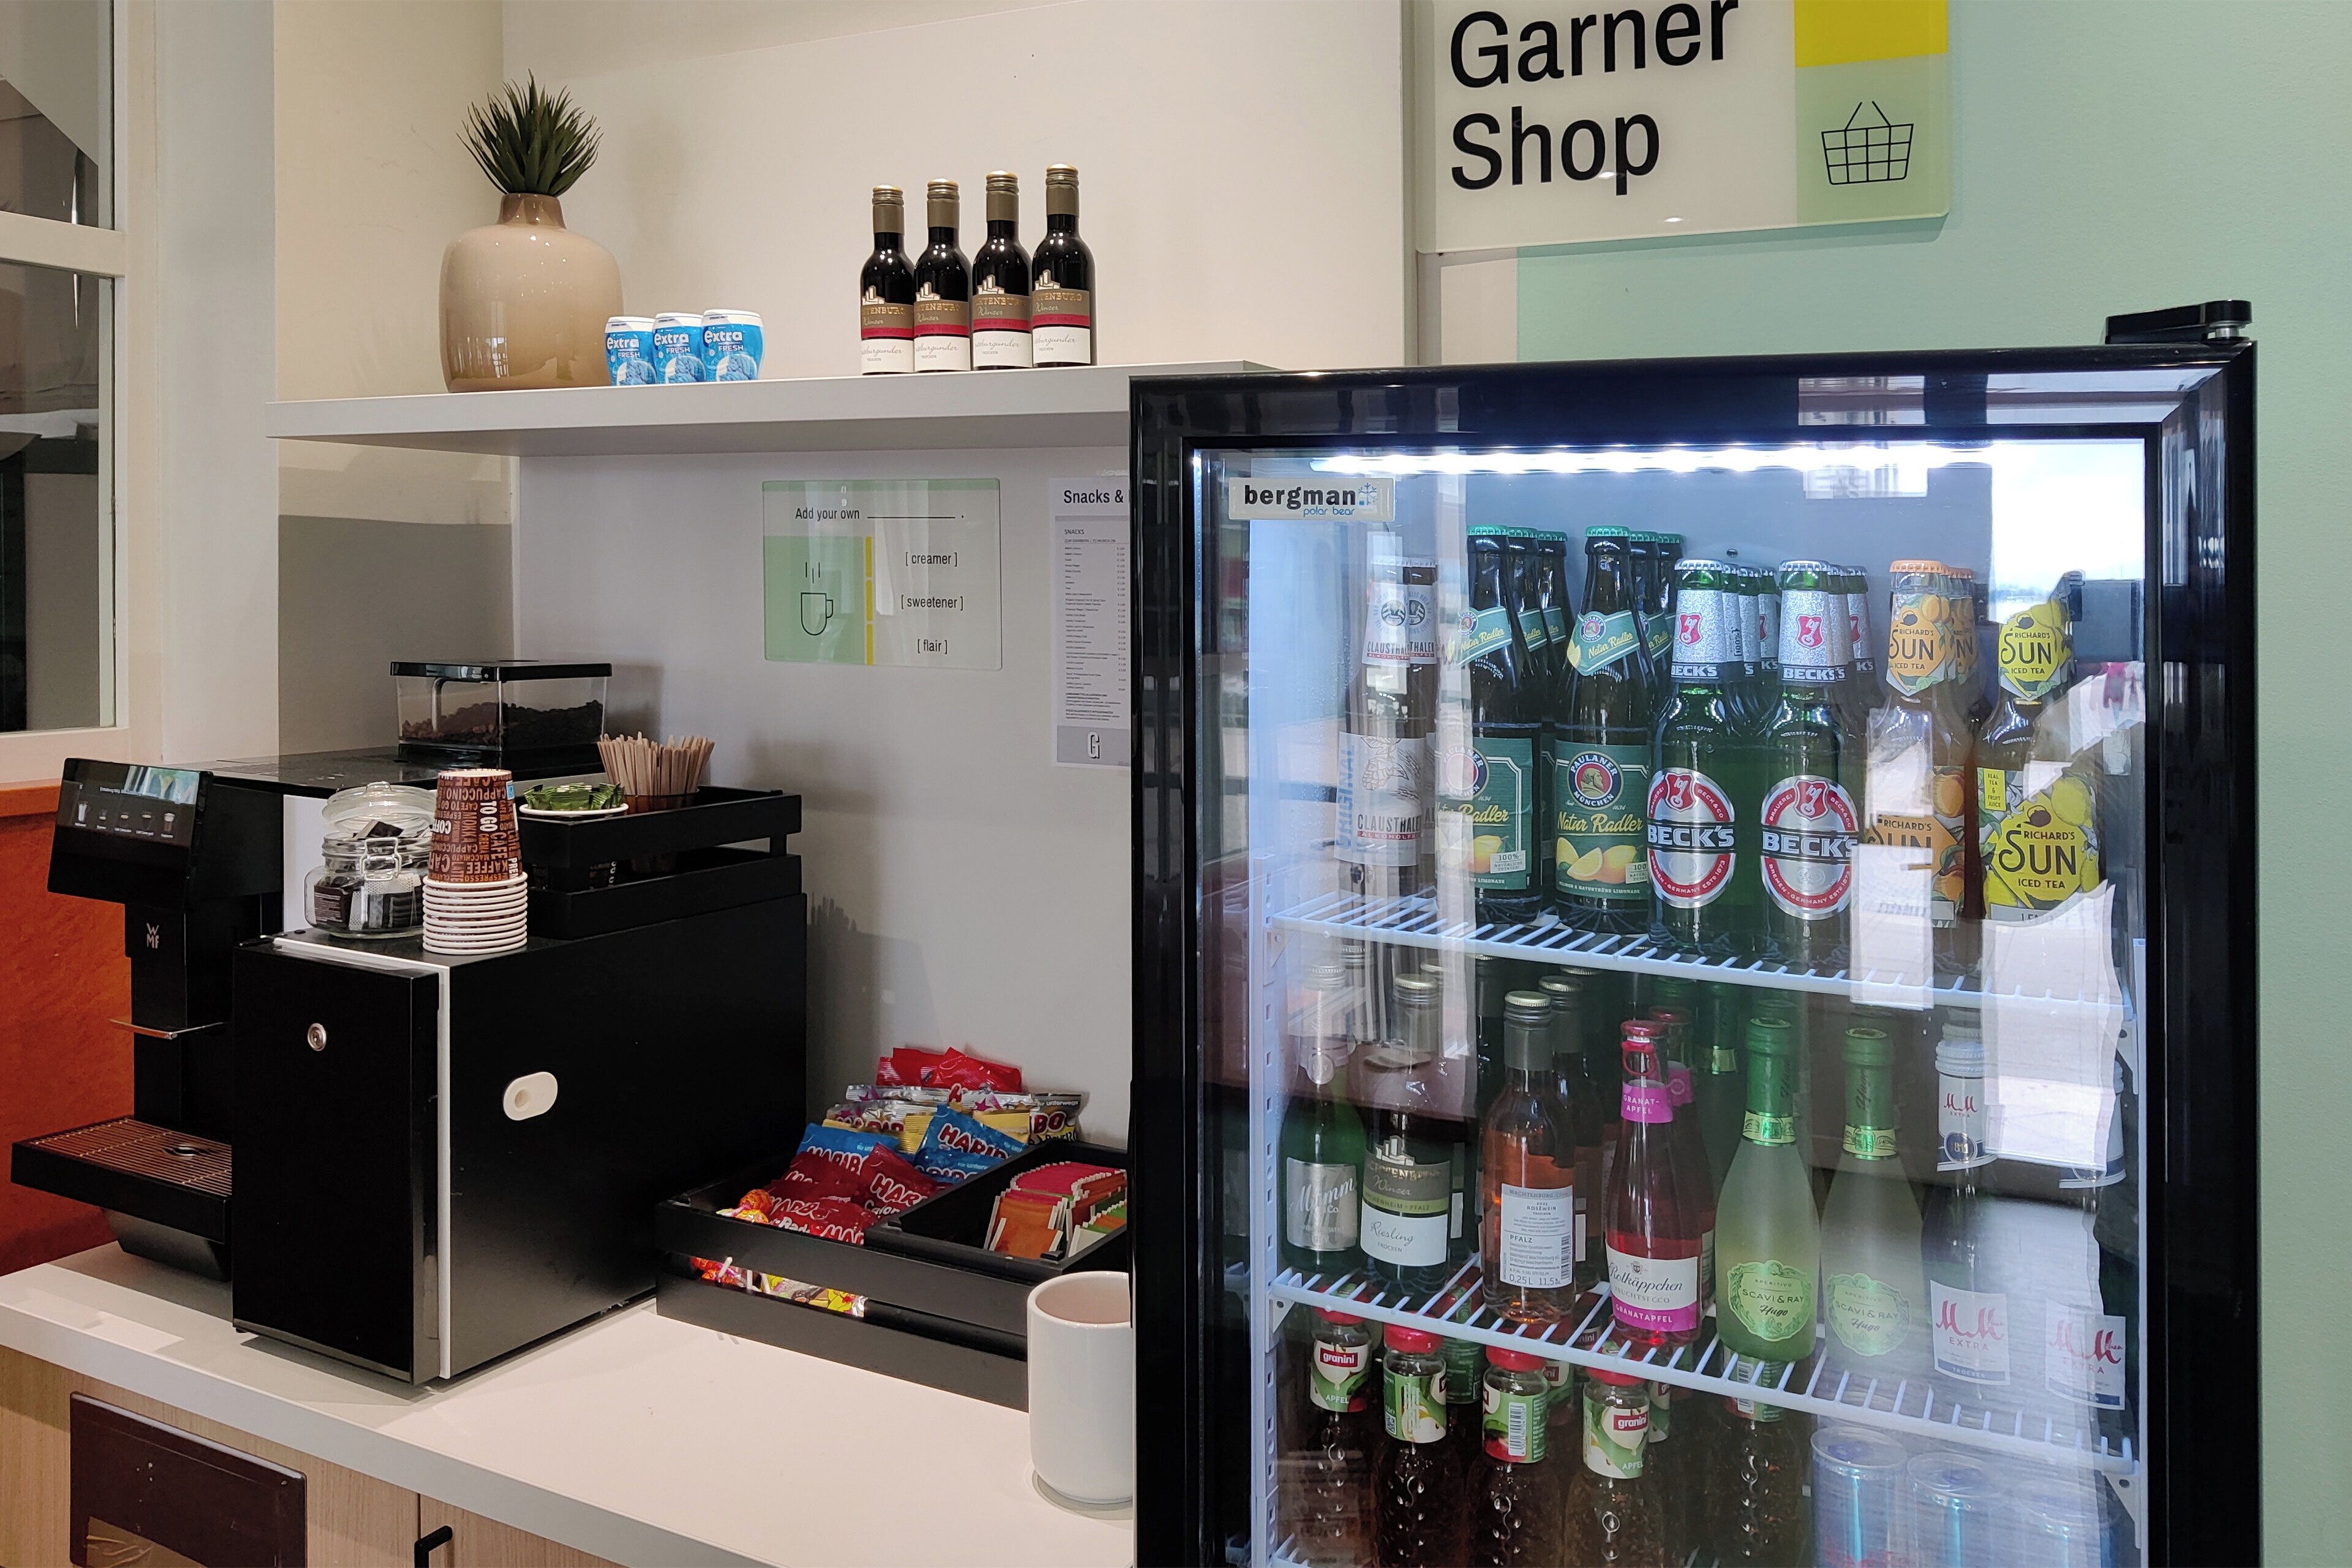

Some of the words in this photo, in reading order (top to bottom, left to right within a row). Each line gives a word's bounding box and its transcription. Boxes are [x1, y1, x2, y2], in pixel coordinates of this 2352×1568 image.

[1450, 0, 1738, 88] Garner
[1451, 106, 1660, 196] Shop
[606, 336, 639, 350] extra
[654, 332, 689, 347] extra
[704, 330, 743, 344] extra
[1063, 489, 1110, 503] Snacks
[1114, 489, 1124, 503] &
[1244, 484, 1356, 510] bergman
[795, 508, 815, 519] Add
[816, 509, 838, 522] your
[840, 508, 860, 519] own
[1303, 506, 1328, 518] polar
[1332, 506, 1355, 516] bear
[1478, 627, 1506, 643] Radler
[1588, 639, 1610, 660] Natur
[1607, 632, 1634, 649] Radler
[1888, 625, 1934, 662] SUN
[2000, 628, 2052, 665] SUN
[1570, 753, 1618, 777] PAULANER
[446, 787, 507, 801] CAPPUCCINO
[1573, 790, 1615, 807] MÜNCHEN
[440, 801, 450, 810] GO
[450, 801, 461, 811] TO
[461, 802, 478, 810] CAFE
[480, 801, 497, 815] TO
[1458, 803, 1509, 824] Radler
[1768, 793, 1793, 822] BRAUEREI
[461, 812, 477, 843] MOKKA
[480, 816, 498, 832] GO
[1557, 811, 1589, 834] Natur
[1590, 812, 1643, 834] Radler
[1883, 820, 1932, 831] RICHARD'S
[478, 833, 489, 854] CREMA
[1647, 824, 1735, 848] BECK'S
[2023, 831, 2076, 840] RICHARD'S
[1762, 831, 1858, 858] BECK'S
[1998, 823, 2077, 875] SUN
[466, 859, 508, 875] KAFFEE
[464, 873, 502, 882] ESPRESSO
[1666, 881, 1701, 894] GERMANY
[1714, 859, 1726, 877] 1873
[1768, 863, 1788, 892] BREMEN
[1789, 893, 1828, 905] GERMANY
[2018, 878, 2041, 888] ICED
[2045, 879, 2065, 889] TEA
[1623, 1095, 1660, 1105] GRANAT-
[1626, 1104, 1653, 1115] APFEL
[1370, 1221, 1415, 1247] Riesling
[1509, 1234, 1532, 1243] PFALZ
[1608, 1261, 1683, 1294] Rotkäppchen
[1754, 1278, 1793, 1287] APERITIVO
[1742, 1287, 1775, 1302] SCAVI
[1777, 1294, 1785, 1303] &
[1616, 1303, 1673, 1323] GRANATAPFEL
[1759, 1303, 1789, 1317] Hugo
[1835, 1300, 1866, 1317] SCAVI
[1867, 1309, 1876, 1319] &
[1877, 1311, 1899, 1320] RAY
[1850, 1316, 1880, 1332] Hugo
[1949, 1336, 1989, 1352] EXTRA
[1322, 1352, 1355, 1365] granini
[1952, 1366, 1986, 1379] TROCKEN
[1325, 1395, 1349, 1404] APFEL
[1618, 1414, 1647, 1430] granini
[1623, 1461, 1644, 1471] APFEL
